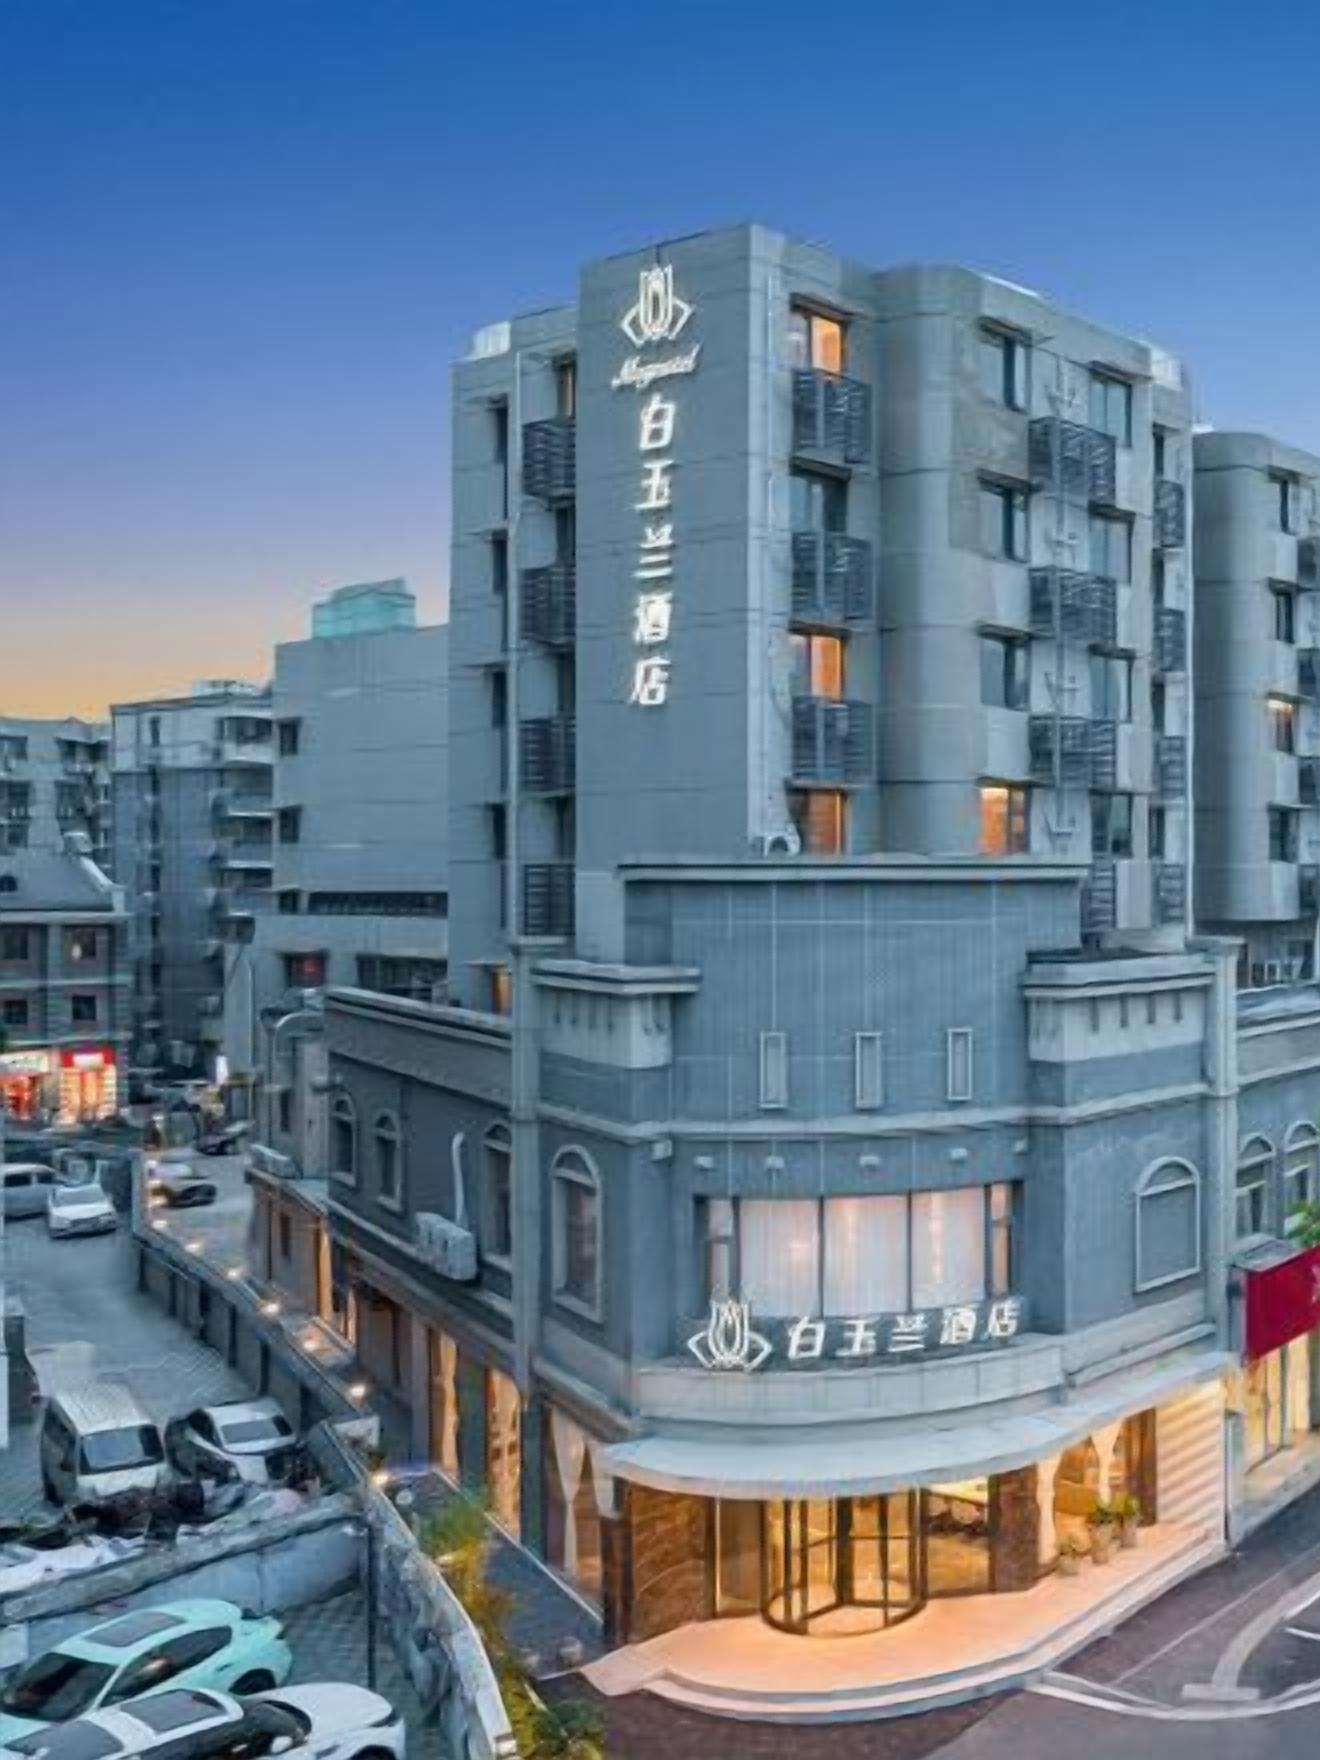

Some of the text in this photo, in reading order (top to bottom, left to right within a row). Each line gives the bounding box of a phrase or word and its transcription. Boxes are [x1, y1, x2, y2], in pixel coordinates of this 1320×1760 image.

[631, 394, 677, 705] 白玉兰酒店
[786, 1300, 1019, 1359] 白玉兰酒店
